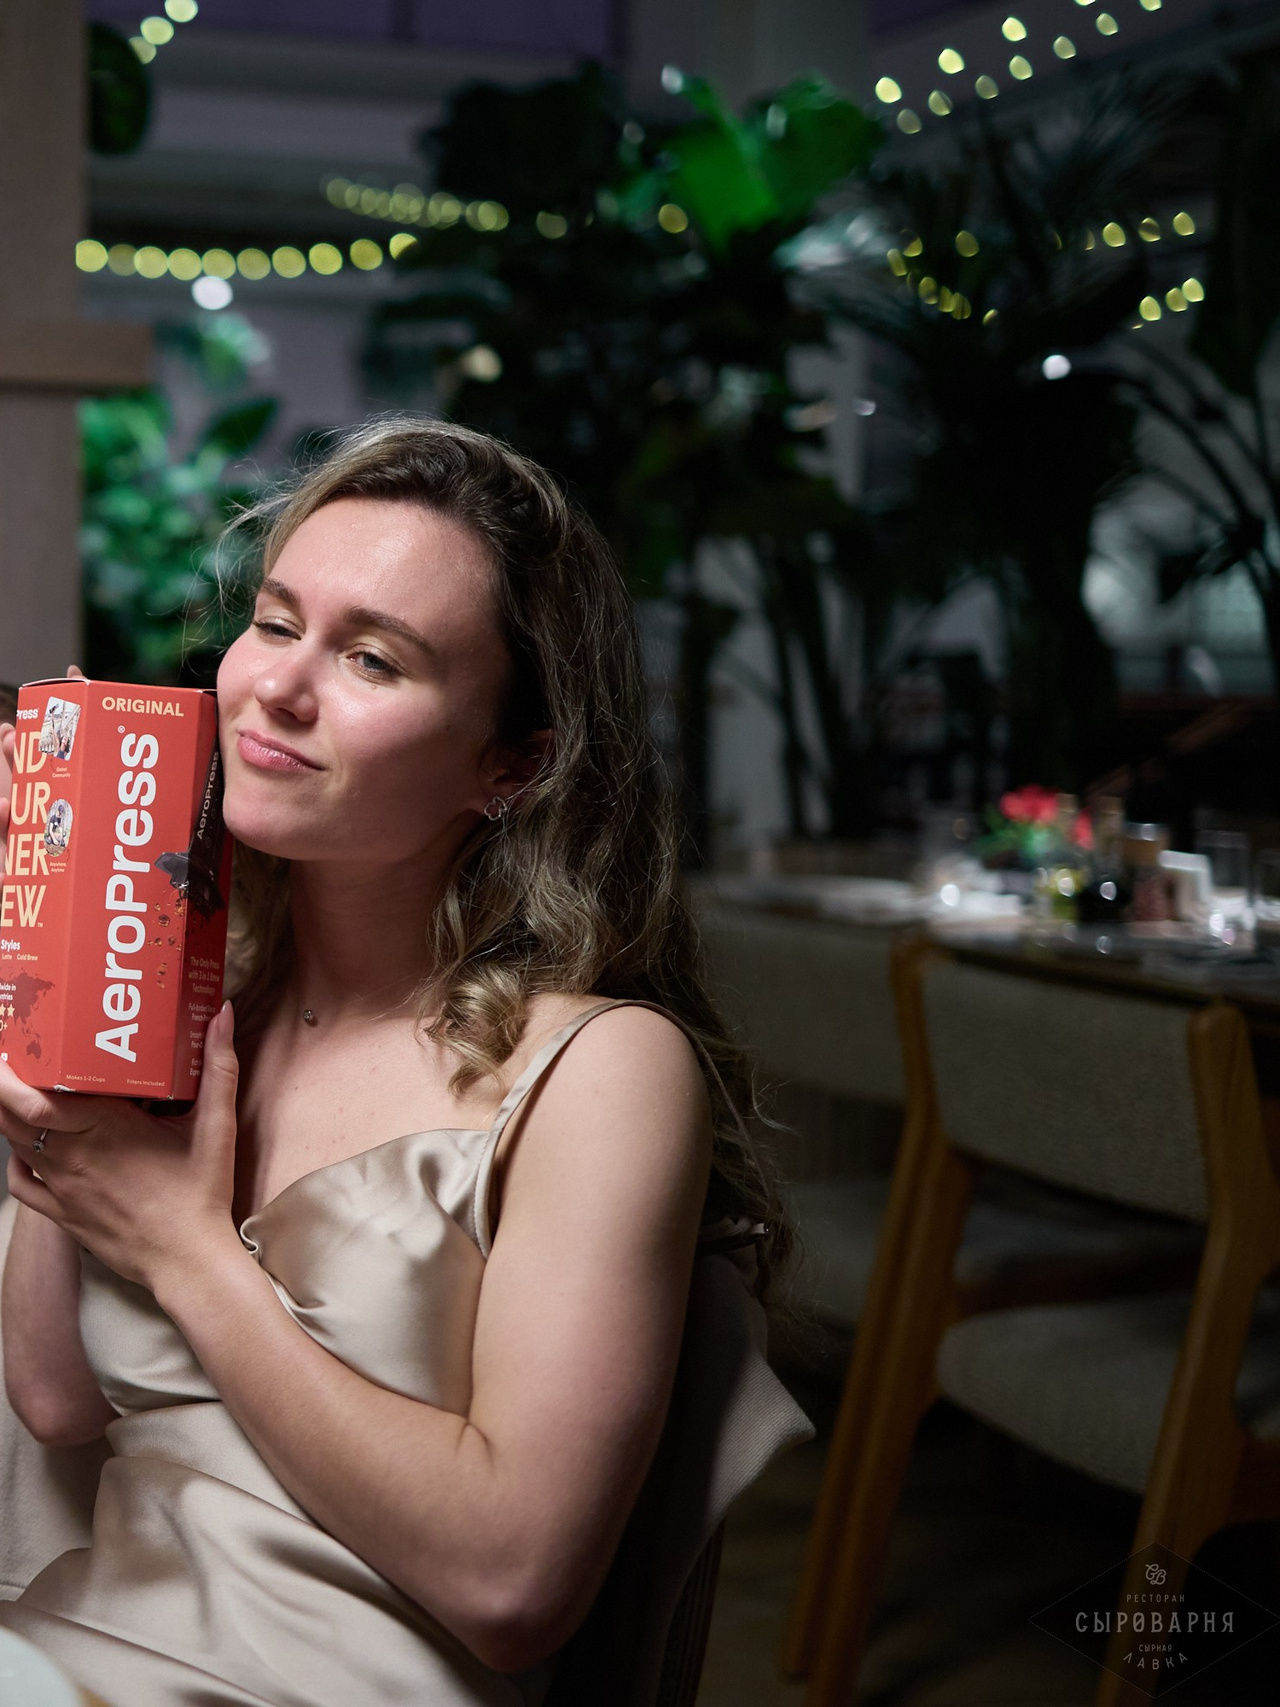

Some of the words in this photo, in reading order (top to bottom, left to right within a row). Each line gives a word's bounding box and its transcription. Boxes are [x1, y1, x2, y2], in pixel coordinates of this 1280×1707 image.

[102, 697, 184, 717] ORIGINAL
[11, 782, 51, 825] UR
[196, 751, 220, 840] AeroPress
[95, 733, 159, 1063] AeroPress
[1, 939, 21, 952] Styles
